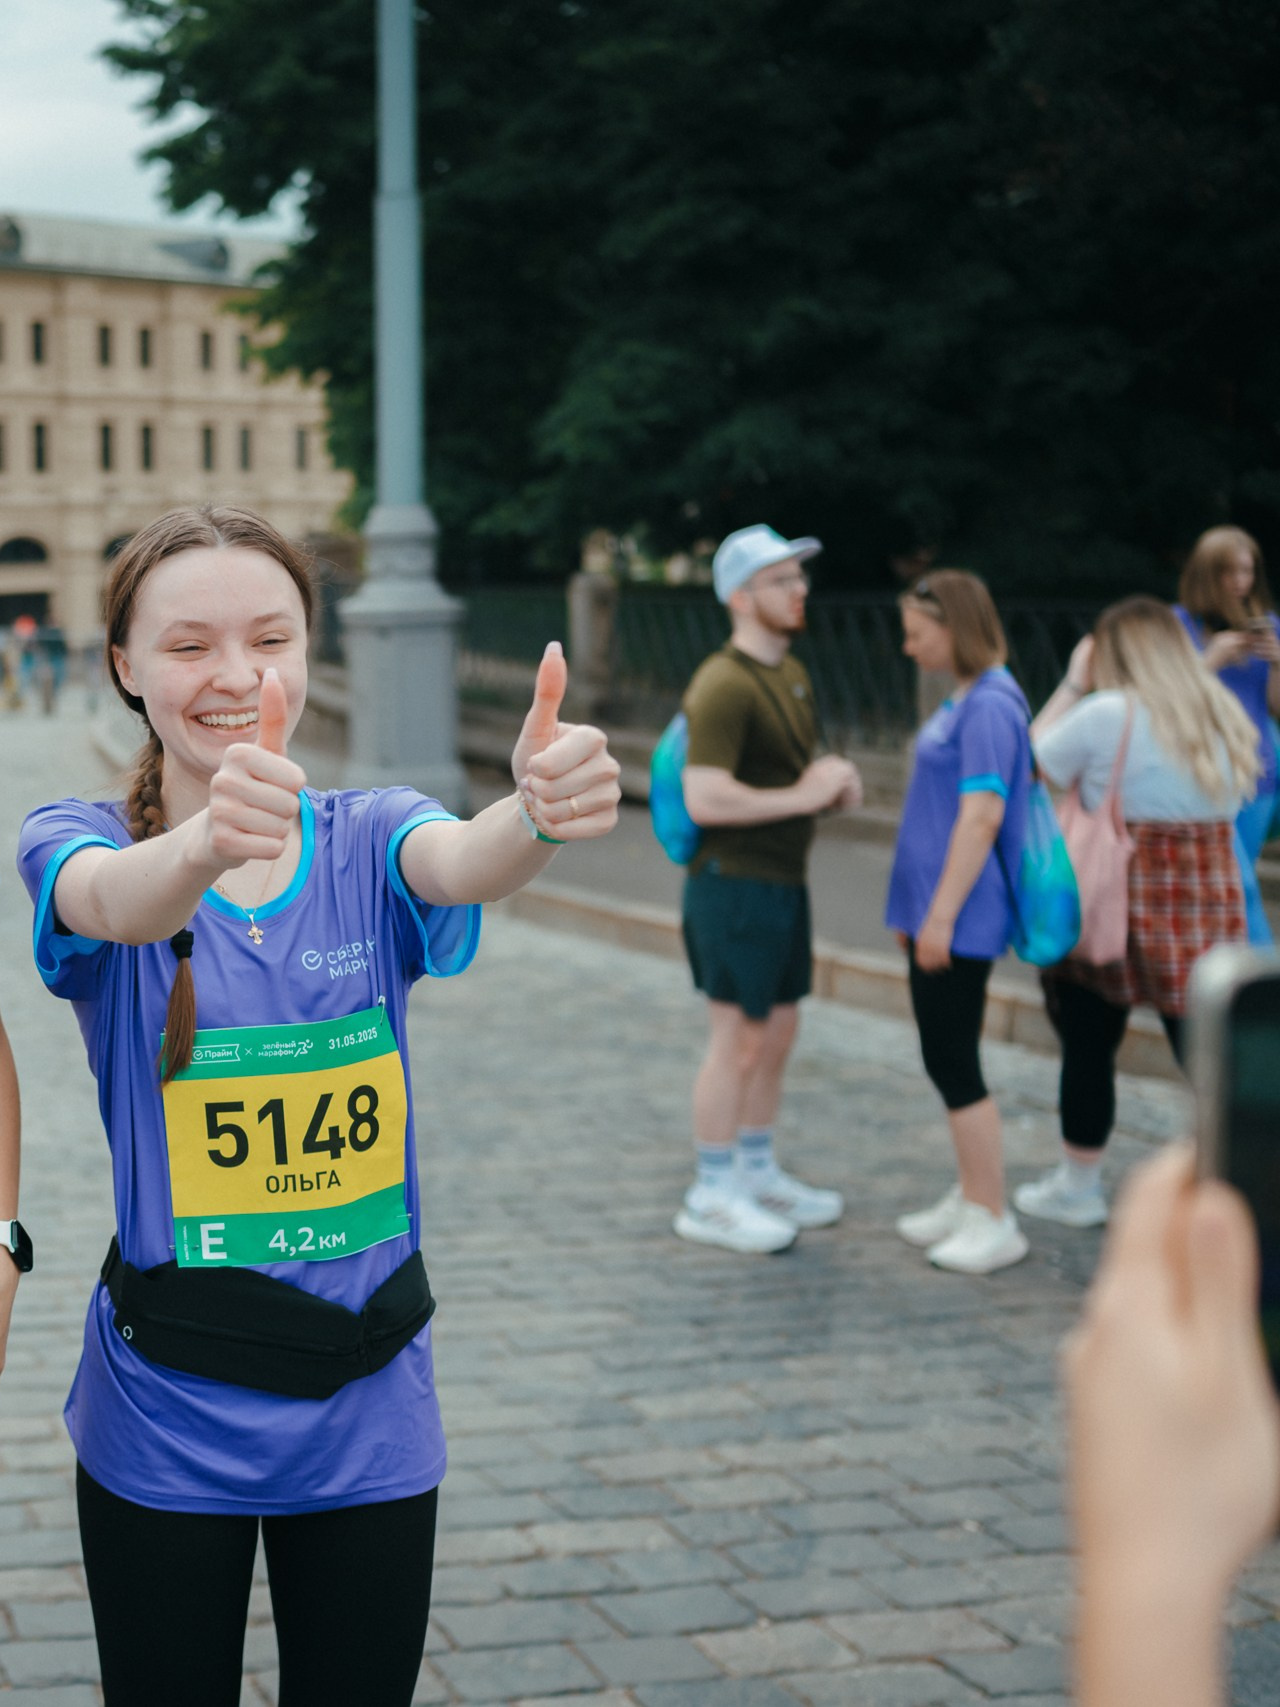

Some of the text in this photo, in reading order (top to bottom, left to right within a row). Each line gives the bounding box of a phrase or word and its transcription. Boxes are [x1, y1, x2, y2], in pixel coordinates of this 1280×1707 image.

[327, 942, 363, 965] СБЕР
[328, 1027, 378, 1050] 31.05.2025
[204, 1049, 233, 1059] Прайм
[258, 1050, 294, 1058] марафон
[205, 1085, 380, 1168] 5148
[266, 1170, 341, 1193] ОЛЬГА
[269, 1227, 316, 1256] 4,2
